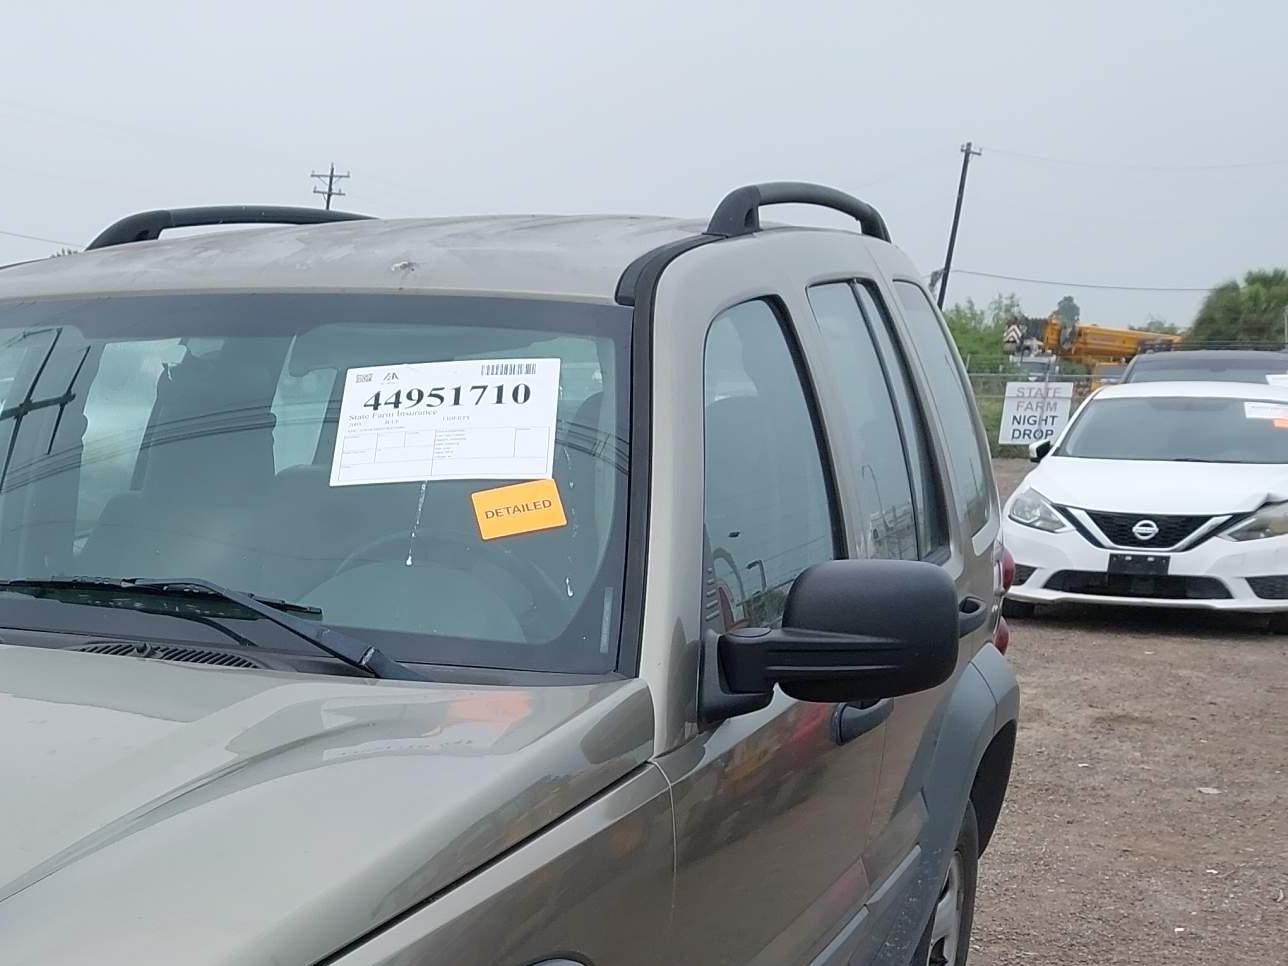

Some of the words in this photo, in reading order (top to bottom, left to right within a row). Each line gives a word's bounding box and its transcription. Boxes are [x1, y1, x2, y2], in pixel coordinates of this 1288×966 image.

[363, 382, 531, 411] 44951710
[1016, 387, 1063, 398] STATE
[1016, 401, 1058, 412] FARM
[1011, 415, 1059, 426] NIGHT
[1011, 428, 1054, 440] DROP
[484, 498, 553, 520] DETAILED
